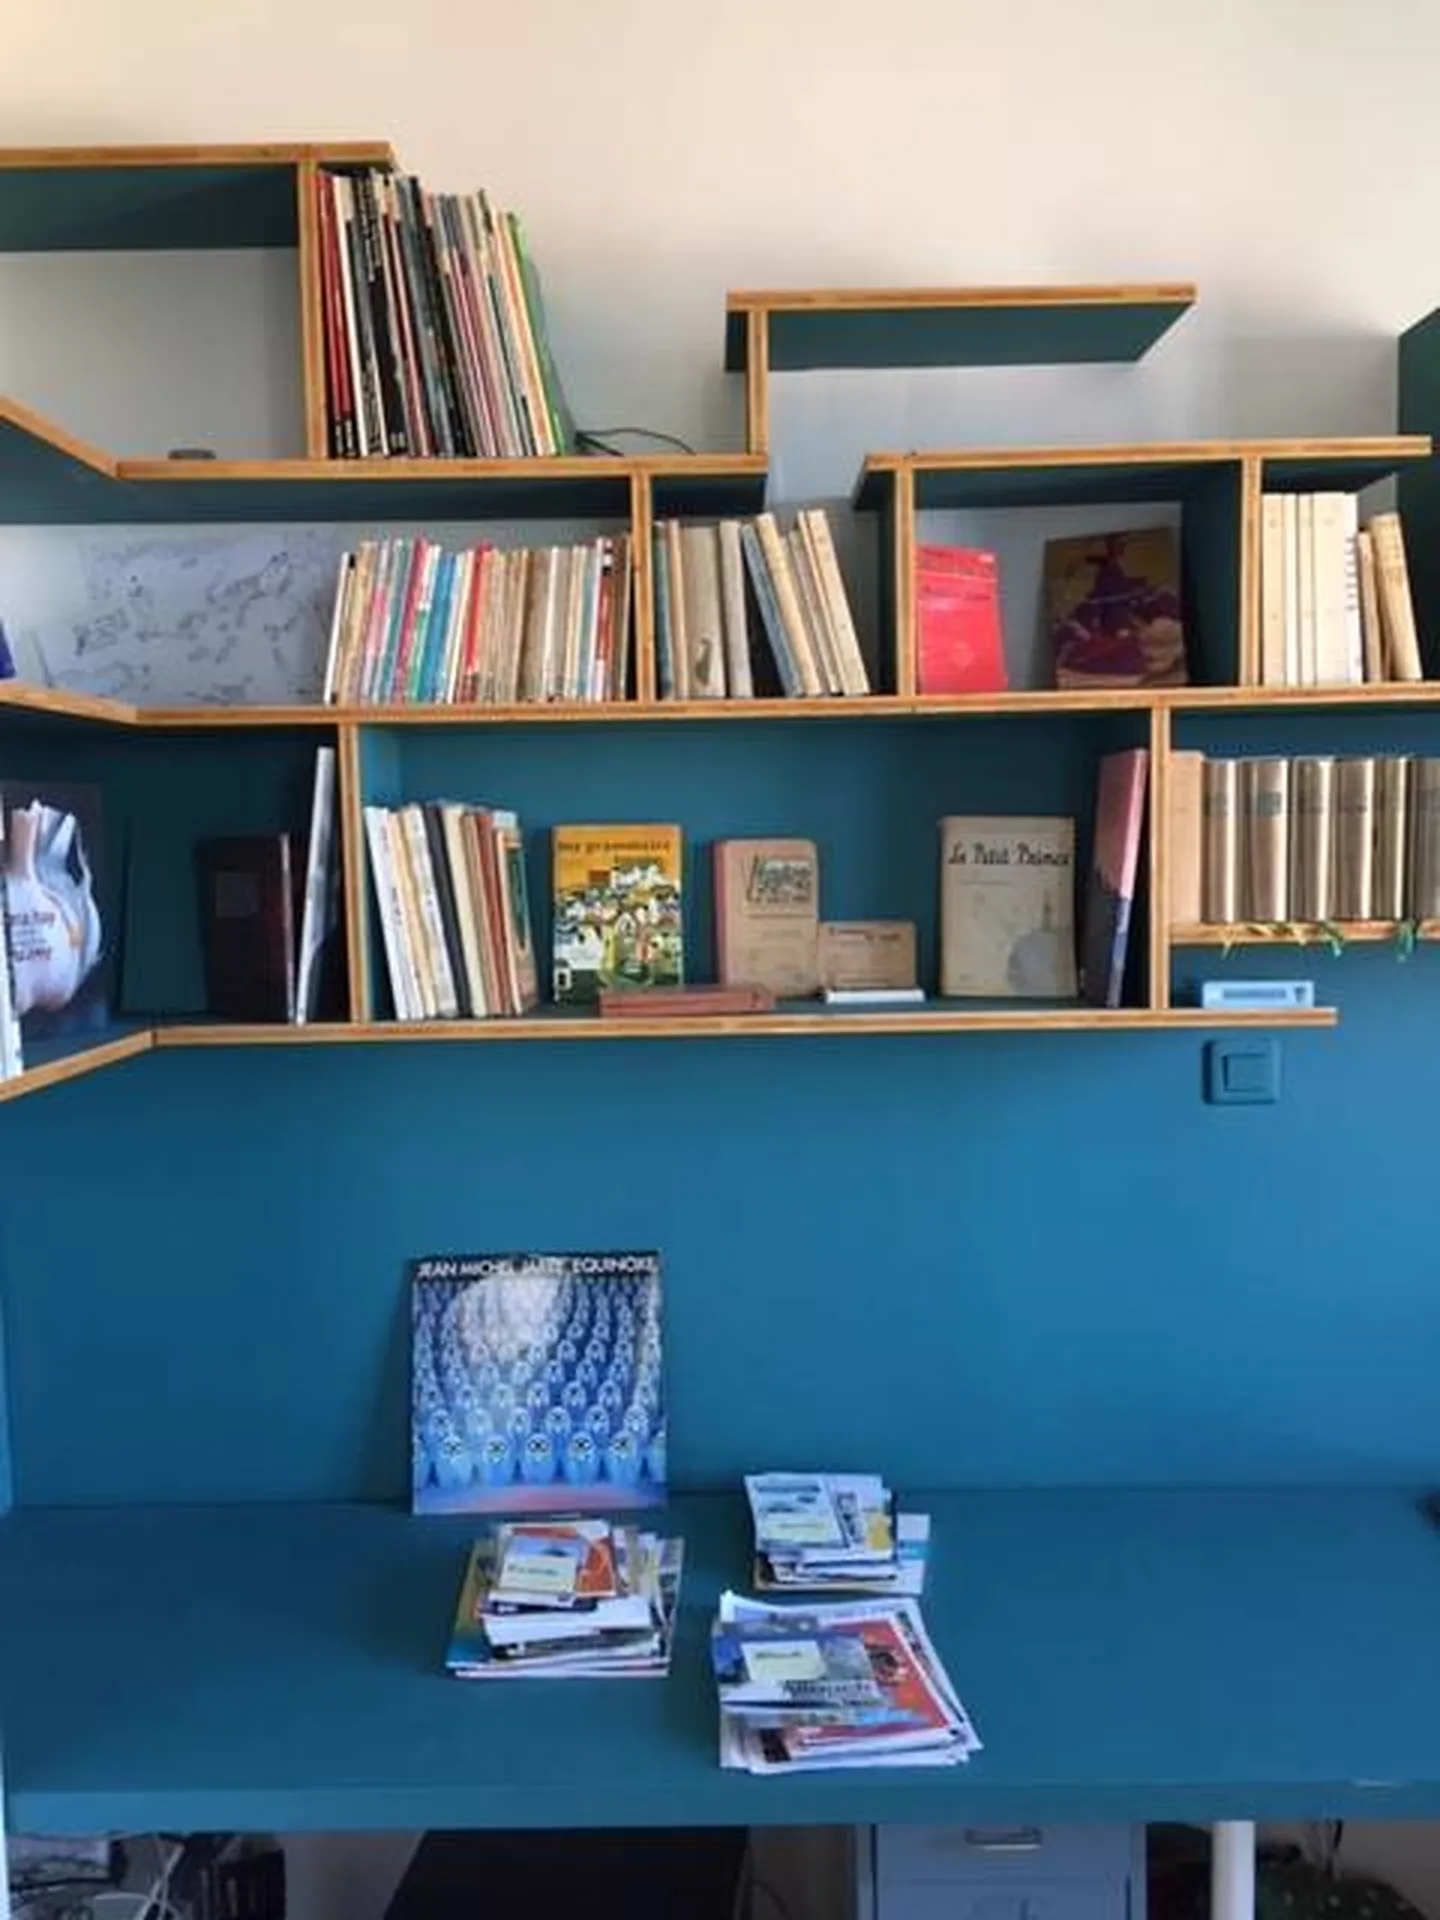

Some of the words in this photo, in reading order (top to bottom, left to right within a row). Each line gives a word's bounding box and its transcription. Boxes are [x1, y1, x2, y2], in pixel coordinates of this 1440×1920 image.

[948, 840, 967, 865] Le
[973, 841, 1010, 865] Petit
[1016, 841, 1070, 867] Prince
[417, 1260, 456, 1278] JEAN
